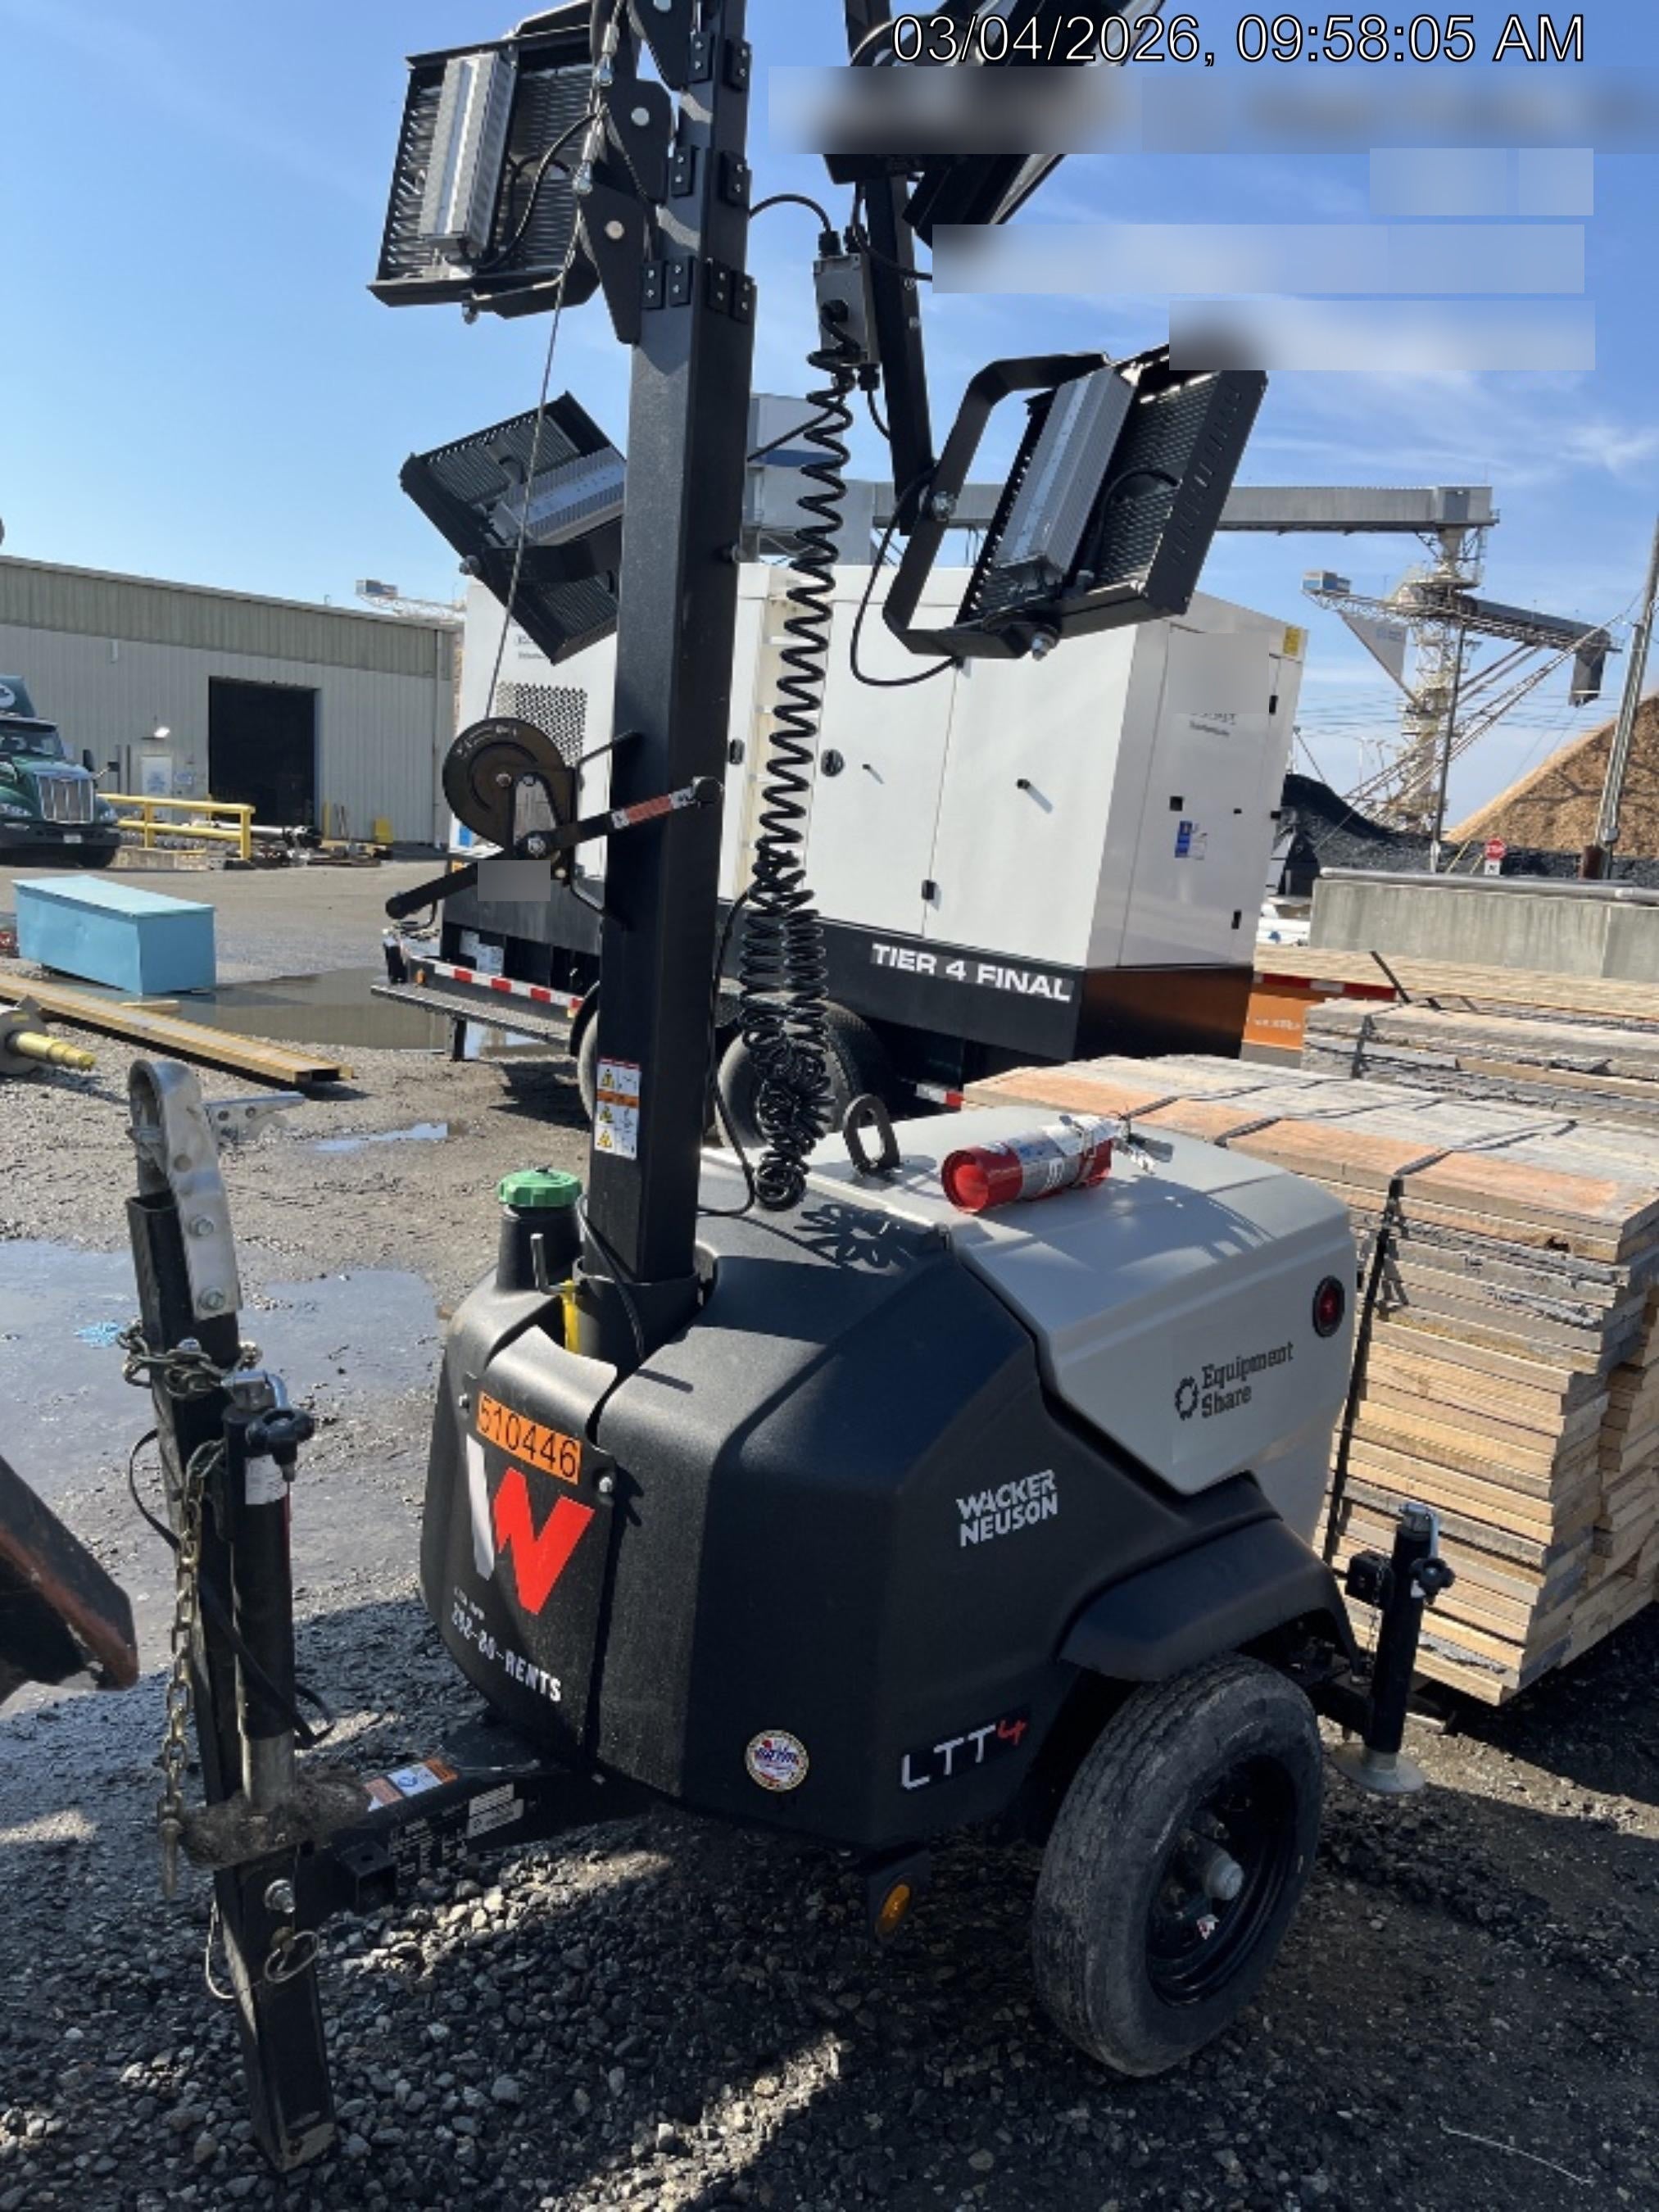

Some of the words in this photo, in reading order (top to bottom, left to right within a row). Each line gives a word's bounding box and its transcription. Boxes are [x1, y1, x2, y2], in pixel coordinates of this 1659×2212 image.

[871, 942, 937, 975] TIER
[945, 959, 967, 981] 4
[977, 963, 1071, 1003] FINAL
[1201, 1341, 1294, 1389] Equipment
[1201, 1386, 1252, 1418] Share
[481, 1395, 577, 1478] 510446
[955, 1469, 1058, 1521] WACKER
[960, 1492, 1058, 1548] NEUSON
